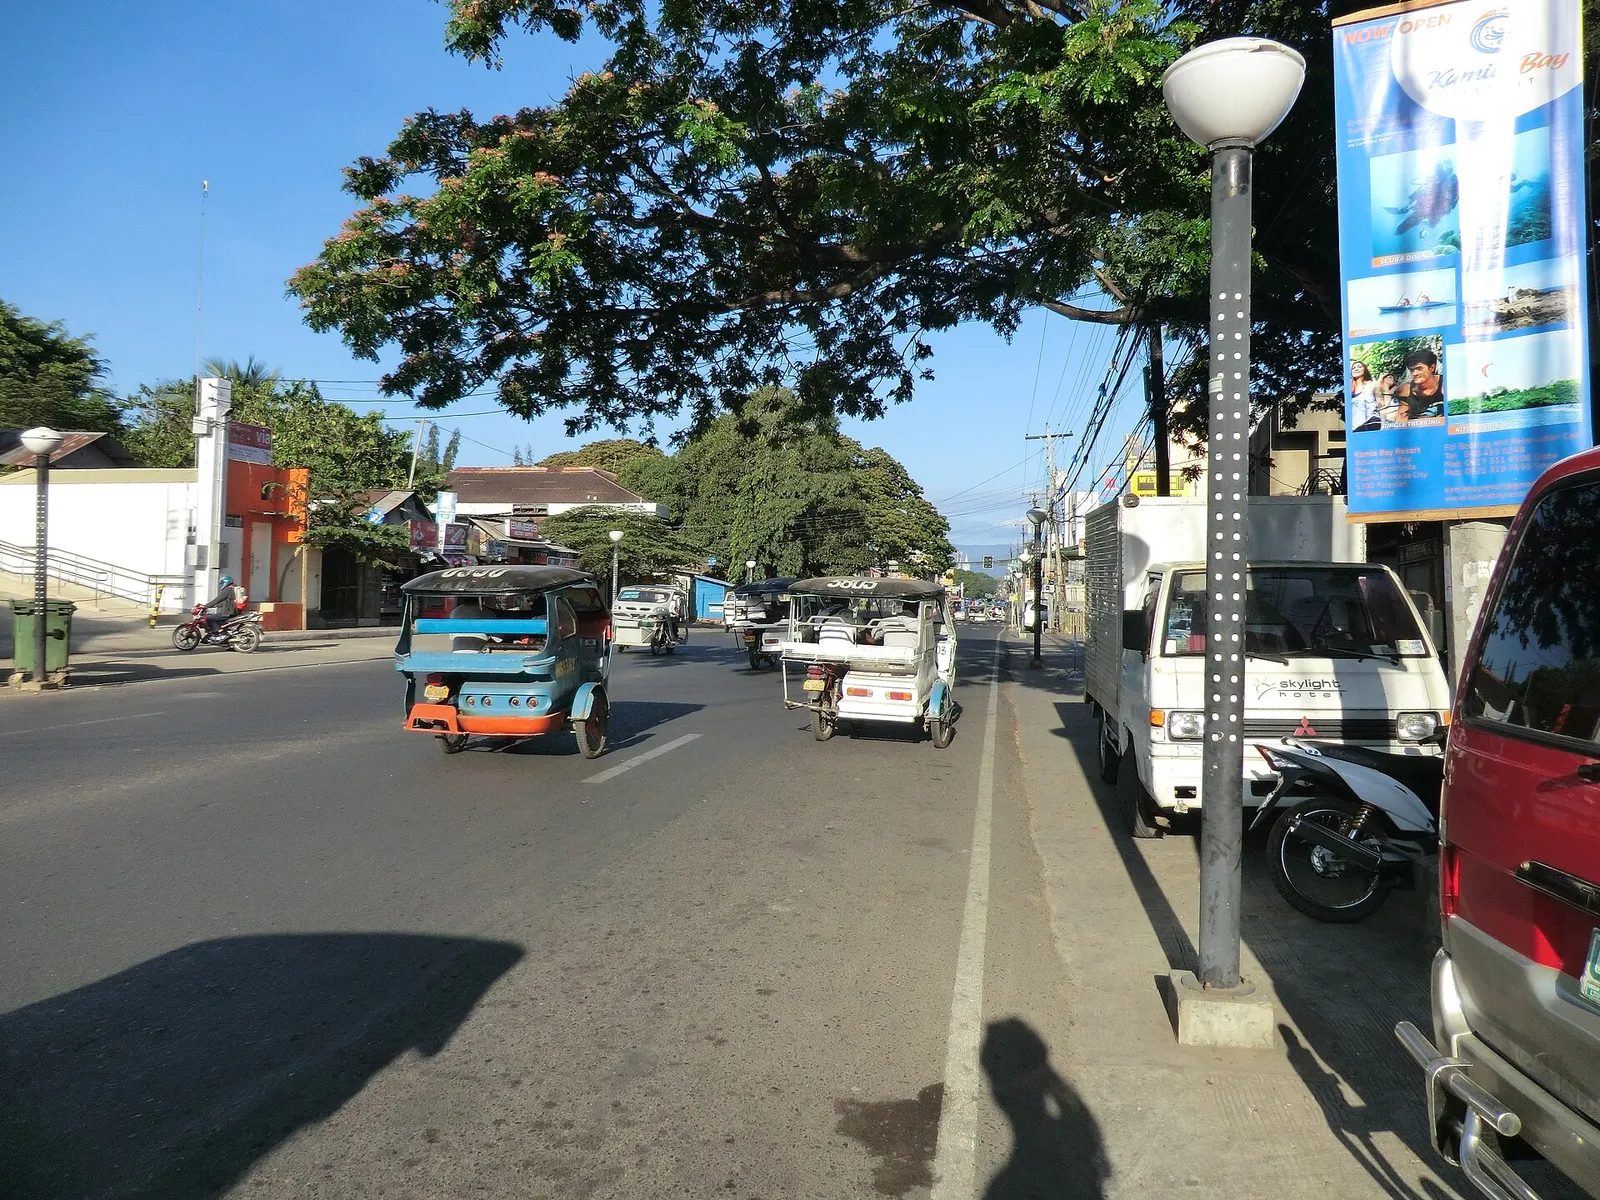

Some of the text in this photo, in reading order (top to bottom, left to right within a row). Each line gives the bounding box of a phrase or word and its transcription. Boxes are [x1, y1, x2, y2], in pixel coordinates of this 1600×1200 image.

[1343, 13, 1452, 46] NOW OPEN
[1428, 63, 1497, 91] Kami
[1519, 52, 1570, 74] Bay
[1379, 256, 1405, 265] SCUBA
[256, 429, 271, 445] via
[1394, 446, 1422, 455] Resort
[1279, 678, 1341, 689] skylight
